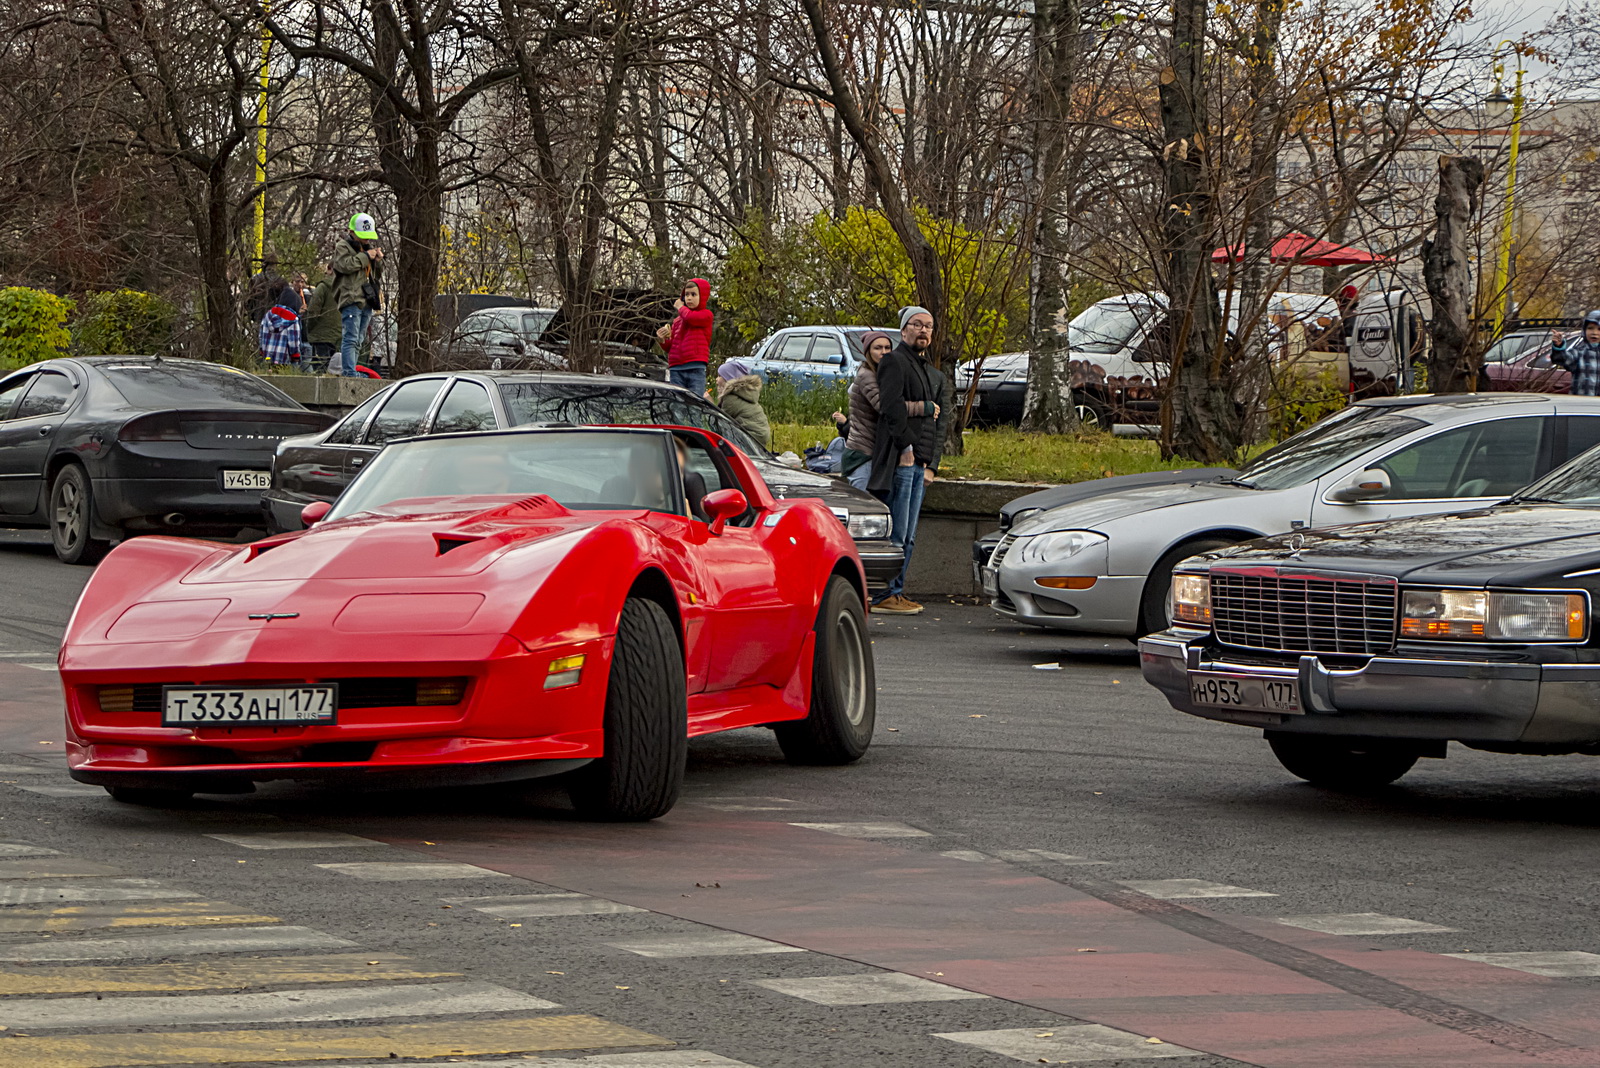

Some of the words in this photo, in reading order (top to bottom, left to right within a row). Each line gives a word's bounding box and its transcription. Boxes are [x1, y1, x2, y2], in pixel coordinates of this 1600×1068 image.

[1267, 682, 1293, 702] 177
[288, 689, 328, 712] 177
[1275, 701, 1289, 710] RUS
[296, 712, 317, 720] RUS
